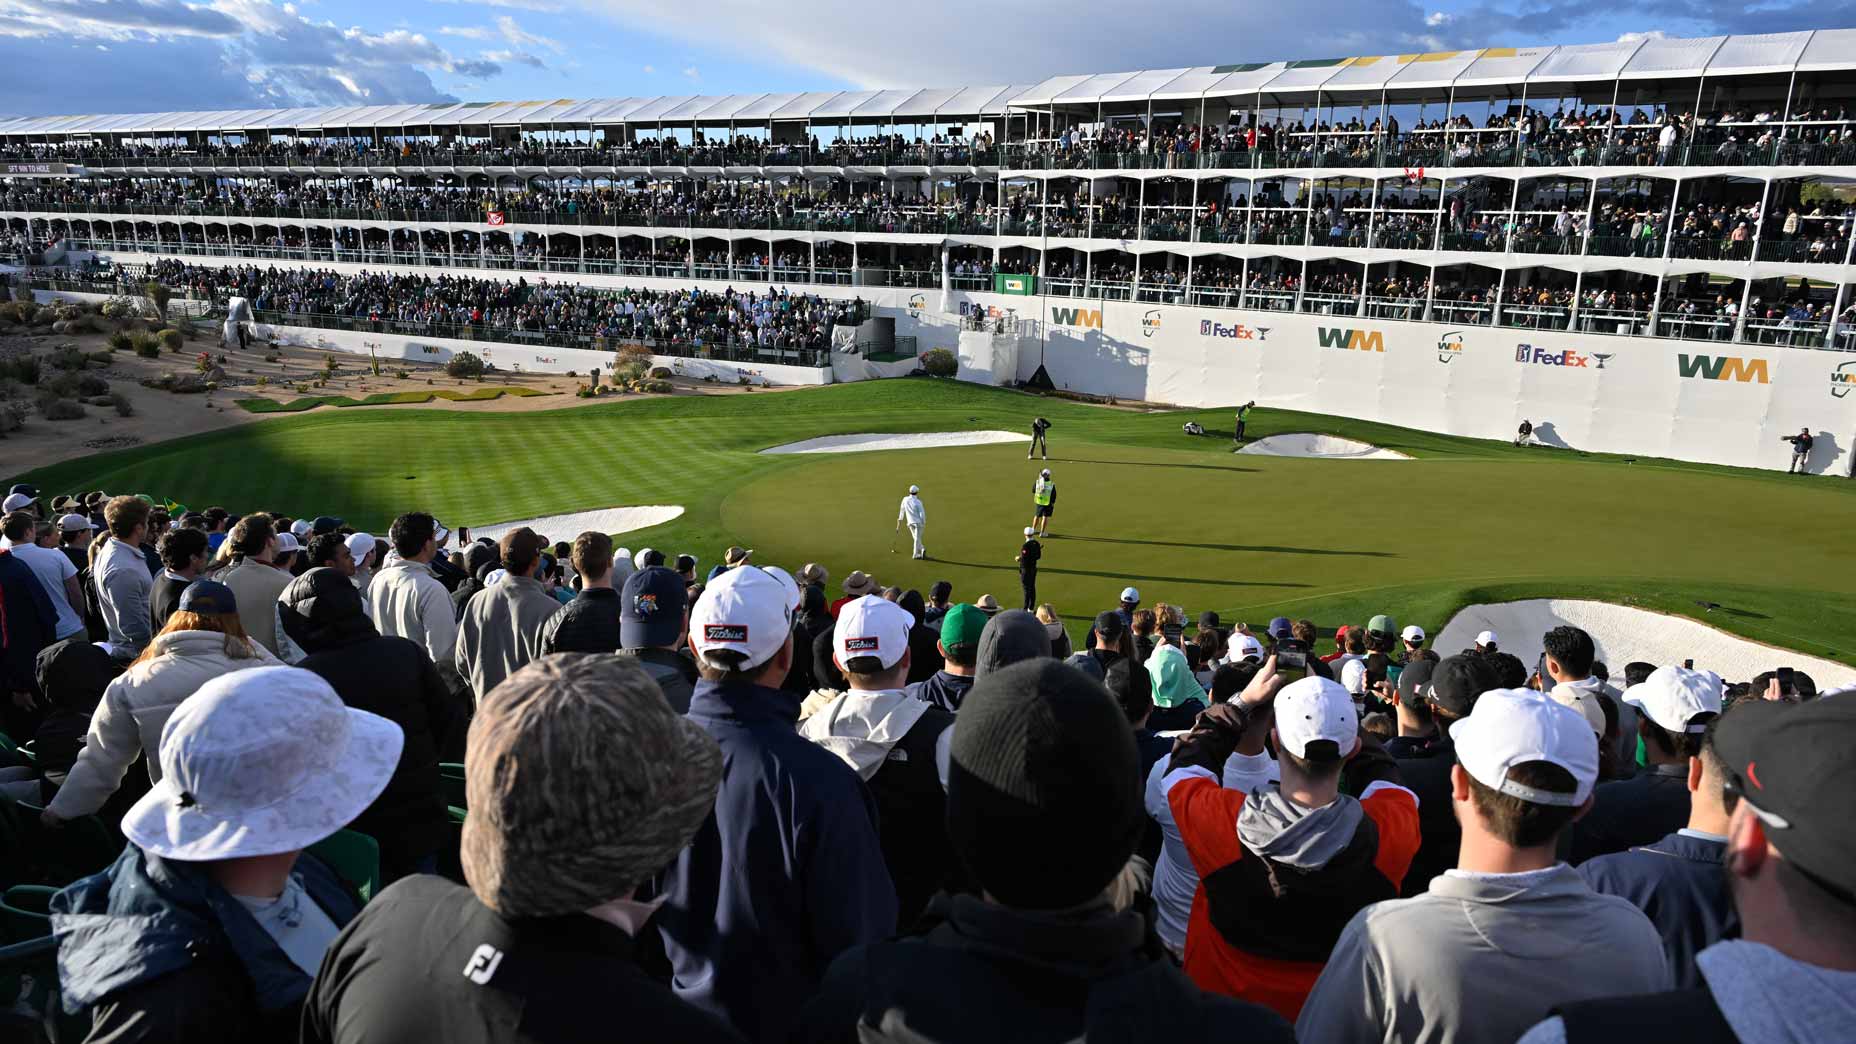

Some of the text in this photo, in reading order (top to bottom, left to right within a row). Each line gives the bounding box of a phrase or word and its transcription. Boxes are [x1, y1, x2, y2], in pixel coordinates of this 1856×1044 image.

[1051, 307, 1102, 328] WM
[1213, 323, 1253, 339] FedEx
[1318, 327, 1384, 352] WM
[1438, 342, 1462, 351] WM
[422, 346, 439, 354] WM
[1533, 348, 1588, 367] FedEx
[1678, 353, 1769, 384] WM
[705, 627, 745, 640] Titleist
[848, 639, 875, 650] Titleist
